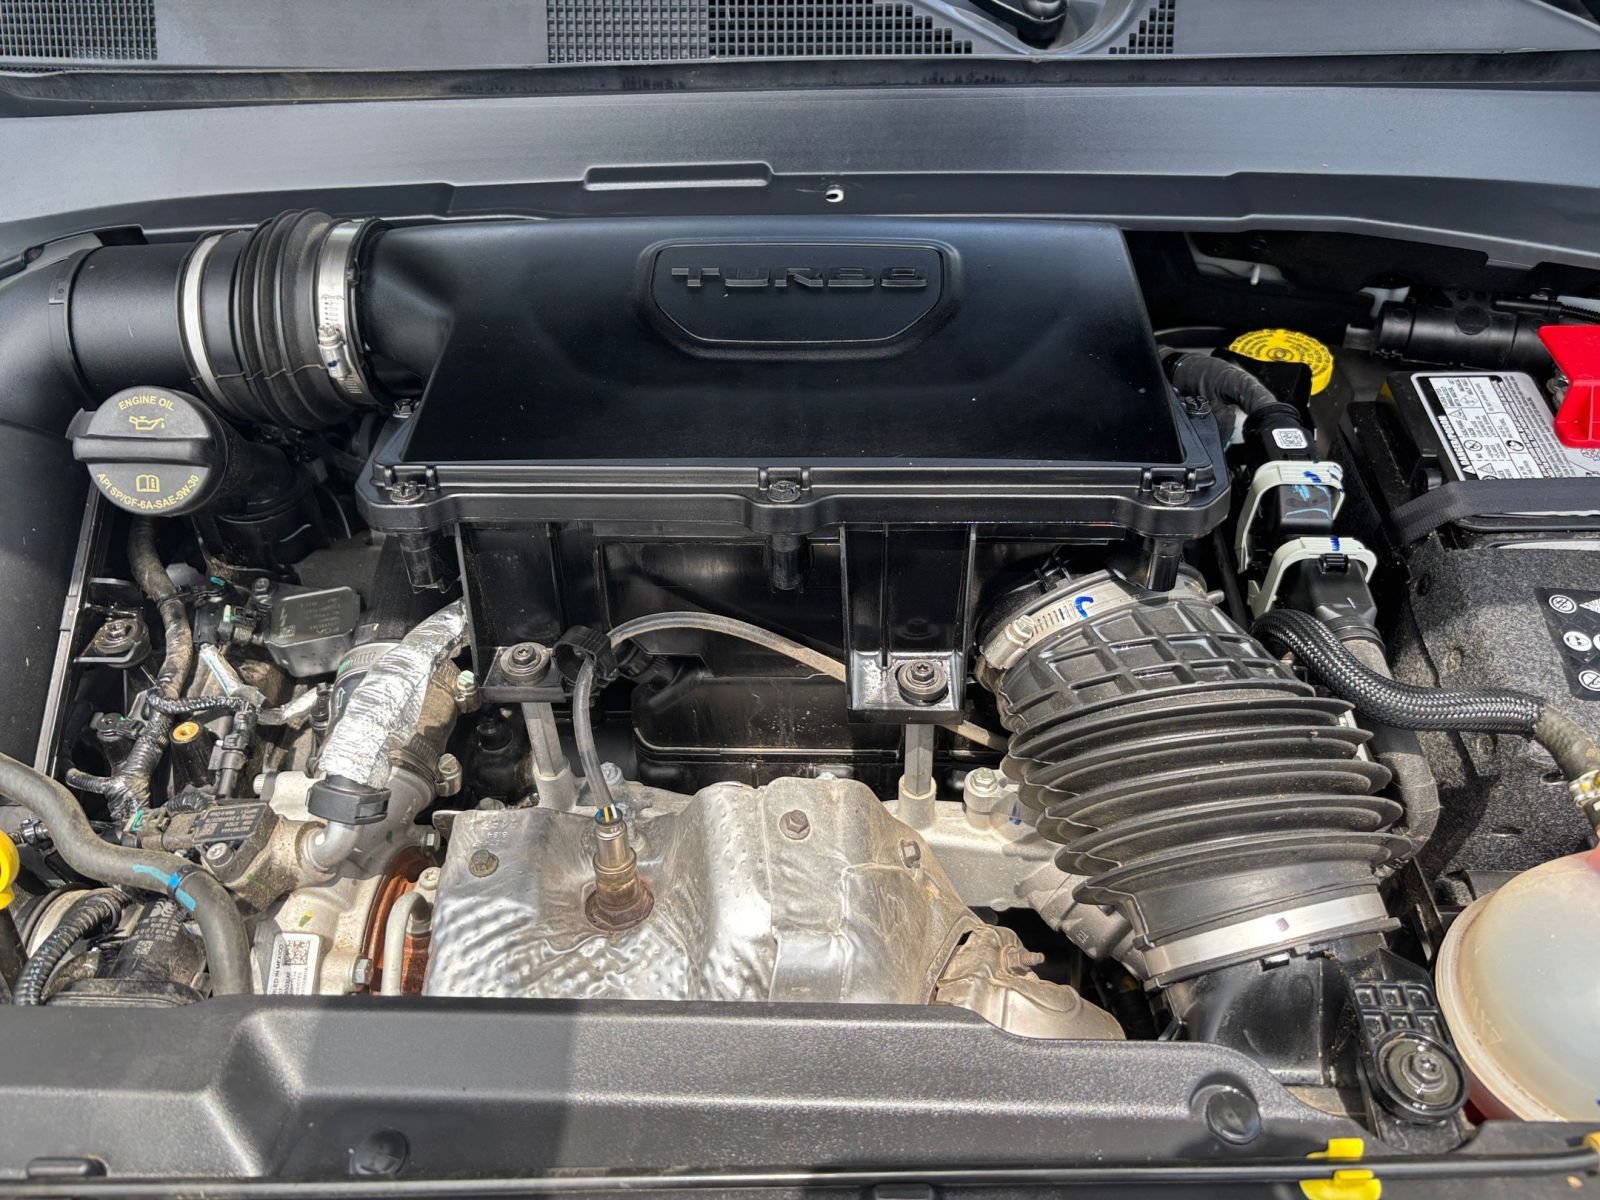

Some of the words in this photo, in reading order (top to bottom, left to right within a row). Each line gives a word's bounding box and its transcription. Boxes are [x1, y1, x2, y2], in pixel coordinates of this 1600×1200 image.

[119, 395, 156, 410] ENGINE
[159, 399, 174, 411] OIL
[97, 473, 111, 489] API
